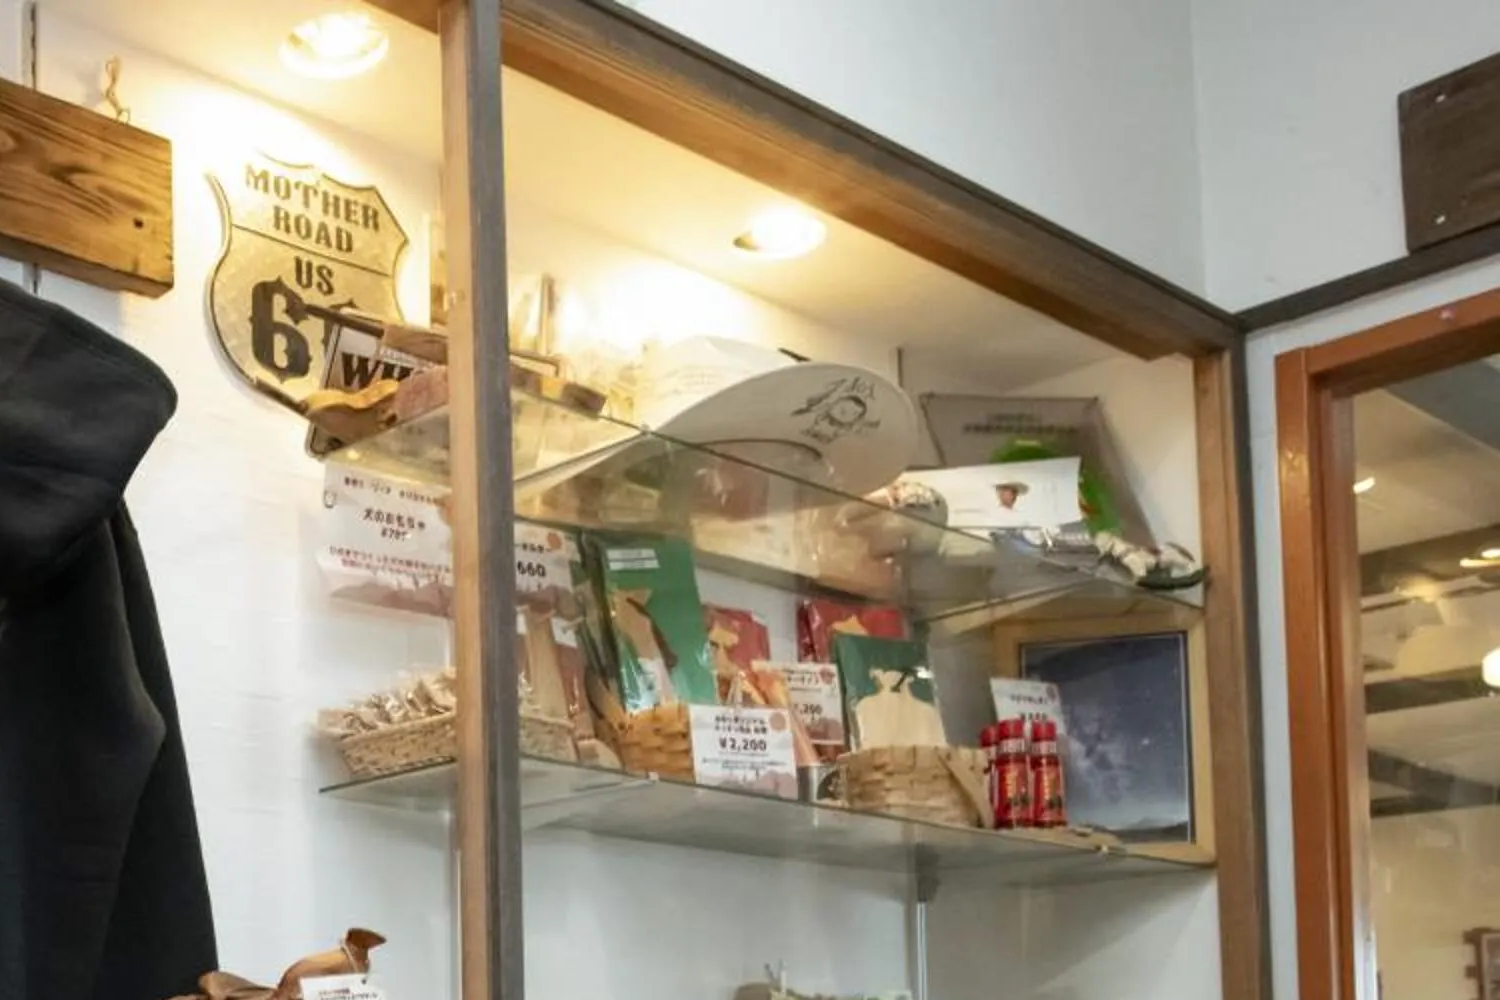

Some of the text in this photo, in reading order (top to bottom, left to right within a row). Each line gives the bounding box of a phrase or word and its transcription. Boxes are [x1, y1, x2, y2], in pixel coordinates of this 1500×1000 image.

[245, 163, 381, 233] MOTHER
[273, 206, 354, 254] ROAD
[294, 256, 335, 297] US
[719, 737, 767, 752] ¥2,200
